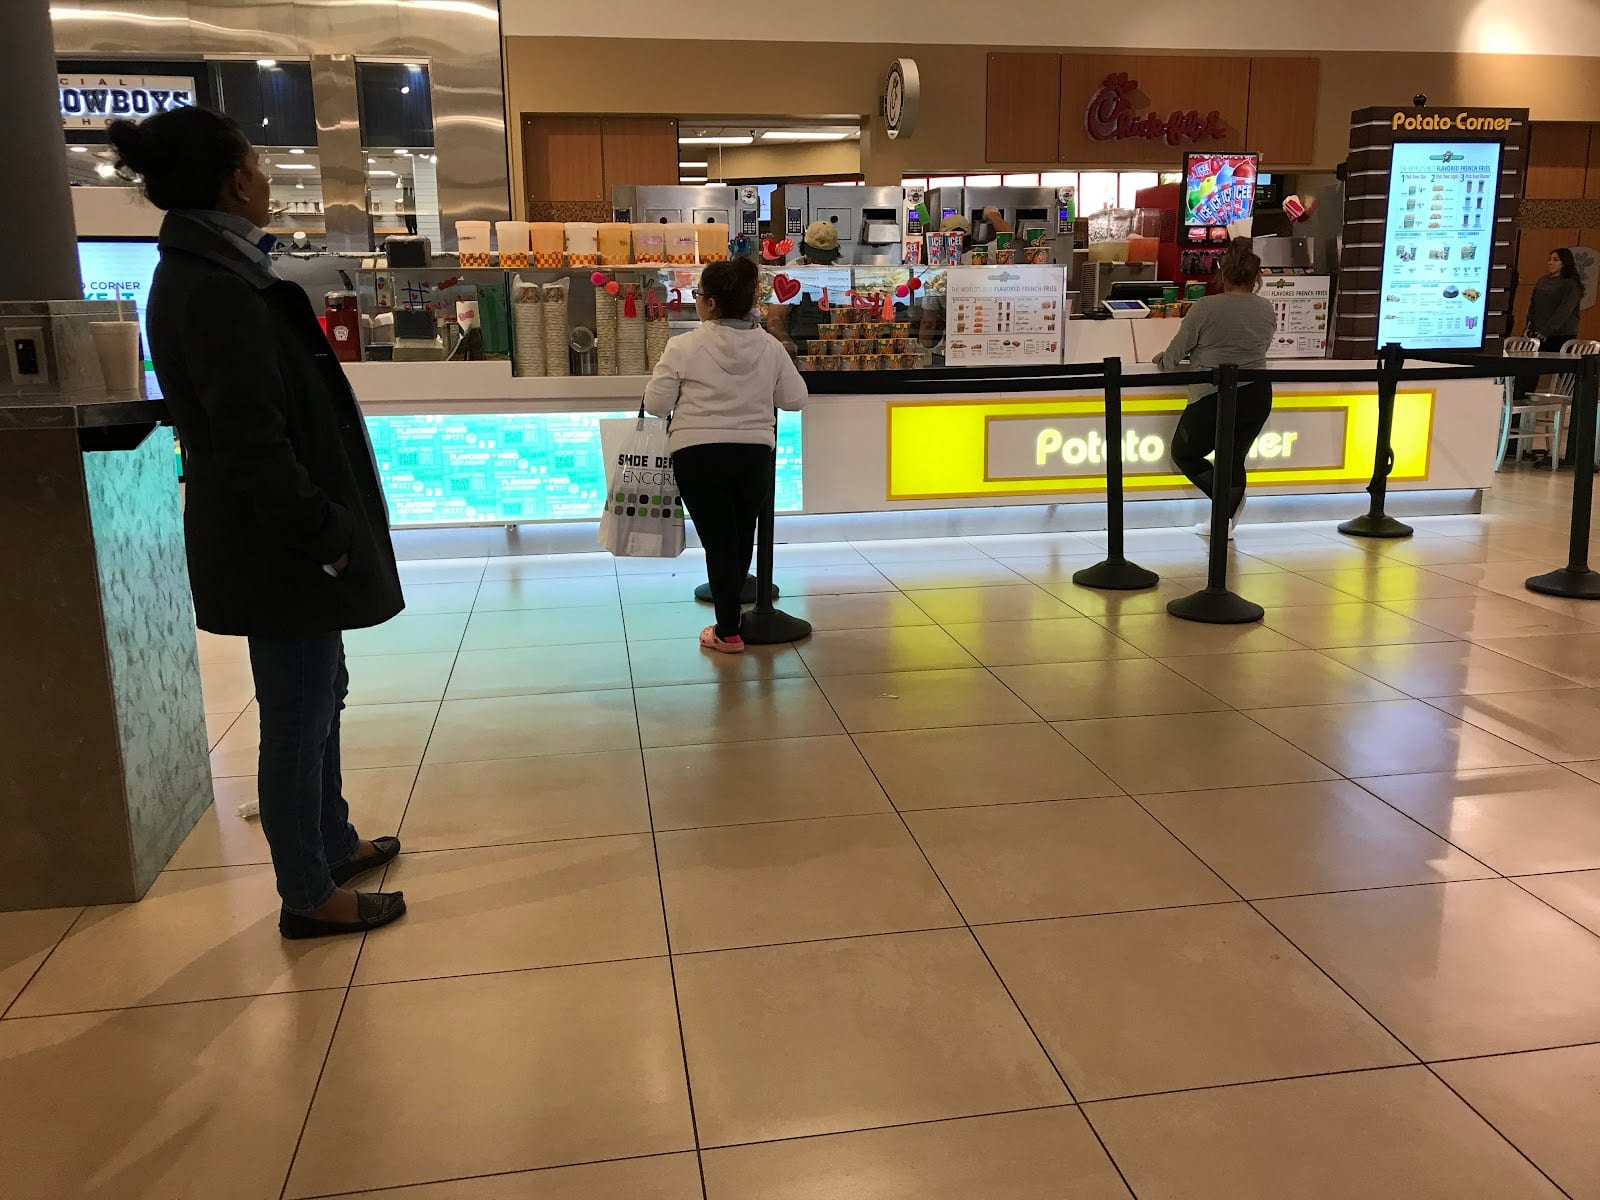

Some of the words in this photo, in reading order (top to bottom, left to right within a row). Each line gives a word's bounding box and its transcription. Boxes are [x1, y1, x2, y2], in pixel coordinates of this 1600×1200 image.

[60, 89, 190, 114] OWBOYS
[1391, 111, 1451, 131] Potato
[1455, 111, 1513, 131] Corner
[1233, 185, 1251, 199] ICEE
[90, 281, 141, 290] CORNER
[1036, 428, 1165, 465] Potto
[618, 454, 649, 467] SHOE
